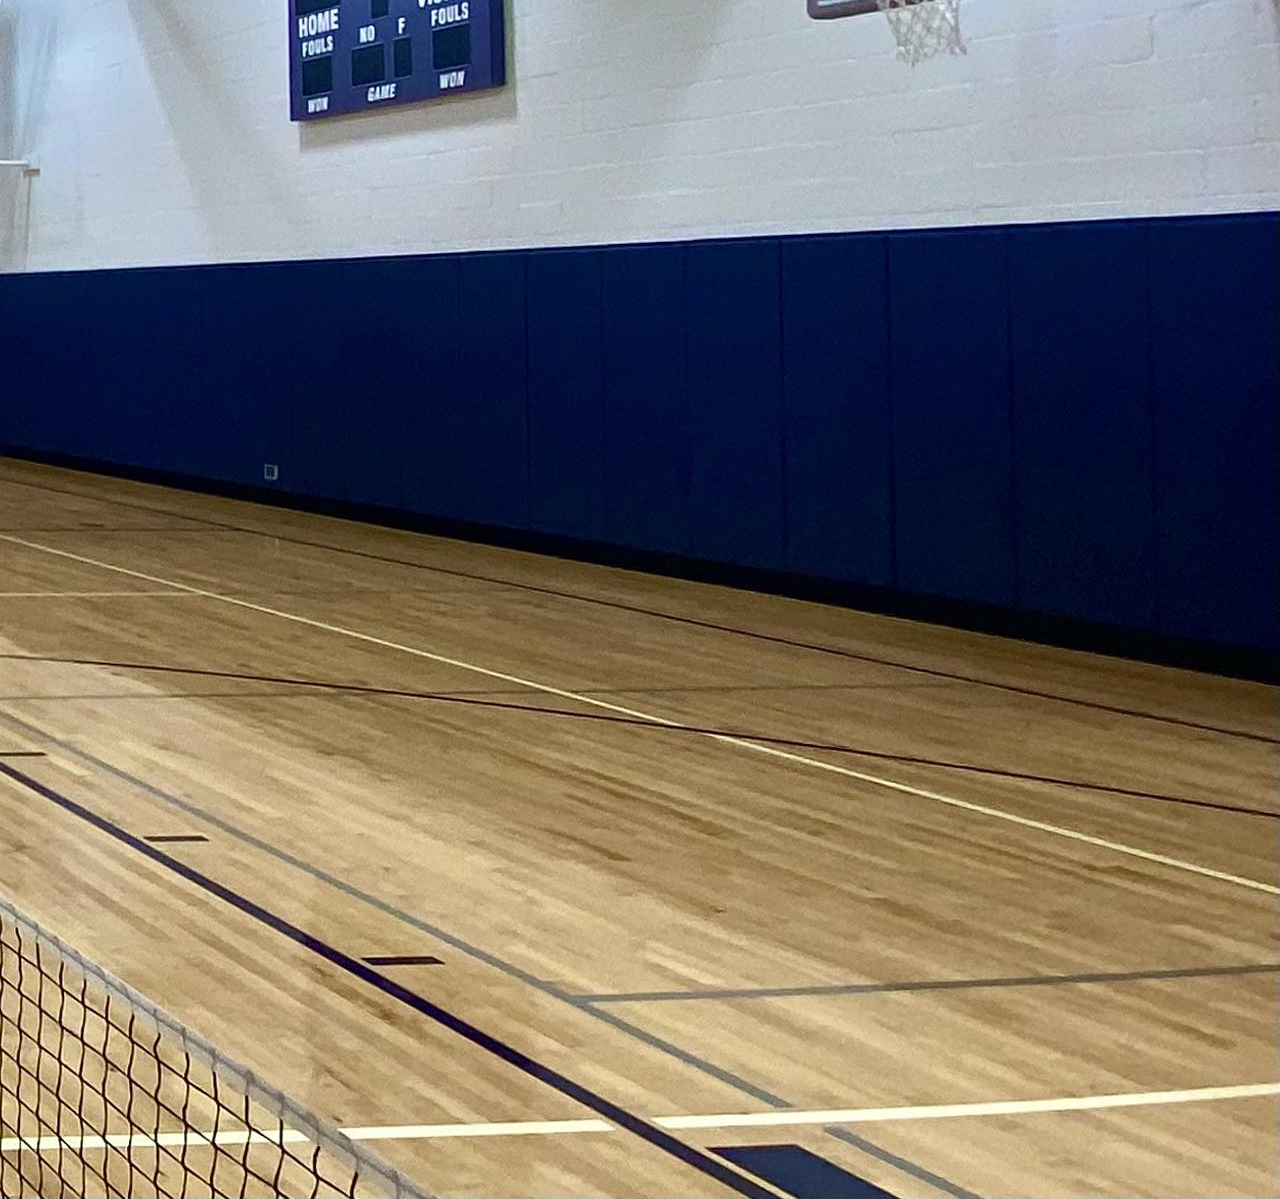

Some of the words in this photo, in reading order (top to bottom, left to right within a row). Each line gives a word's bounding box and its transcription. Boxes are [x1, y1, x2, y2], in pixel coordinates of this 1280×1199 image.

[298, 8, 338, 38] HOME
[431, 2, 469, 27] FOULS
[359, 25, 375, 43] NO
[398, 17, 406, 35] F
[302, 35, 334, 58] FOULS
[440, 70, 465, 90] WON
[367, 83, 396, 102] GAME
[308, 96, 328, 114] WON
